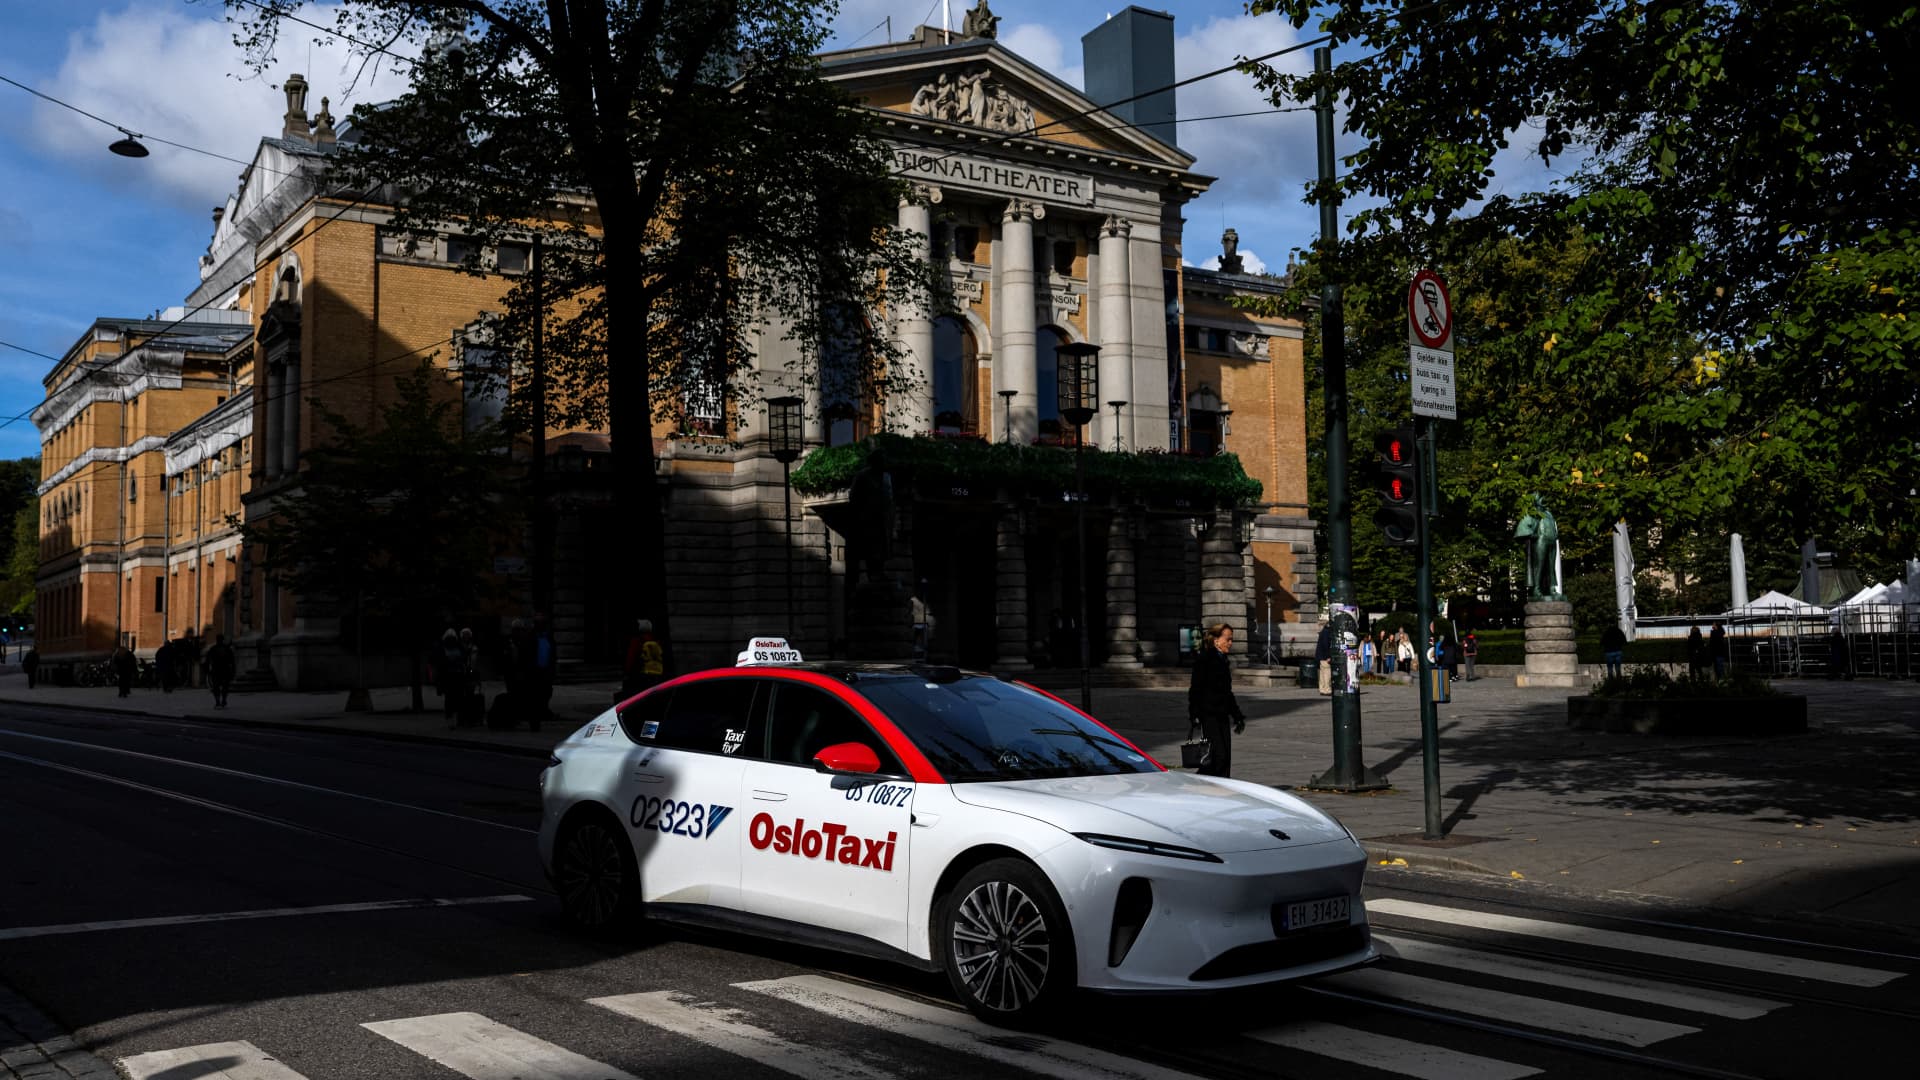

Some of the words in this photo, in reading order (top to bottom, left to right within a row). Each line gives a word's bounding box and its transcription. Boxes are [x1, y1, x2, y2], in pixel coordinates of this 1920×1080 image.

[887, 151, 1081, 198] ATIONALTHEATER
[1417, 352, 1436, 364] Gjelder
[1430, 370, 1441, 380] taxi
[1442, 374, 1449, 383] og
[1421, 384, 1439, 397] kjøring
[754, 651, 768, 661] OS
[769, 651, 798, 661] 10872
[724, 729, 746, 743] Taxi
[845, 781, 863, 801] OS
[866, 784, 913, 807] 10872
[630, 794, 705, 838] 02323
[749, 812, 897, 871] OsloTaxi
[1292, 905, 1306, 926] EH
[1312, 899, 1347, 922] 31432
